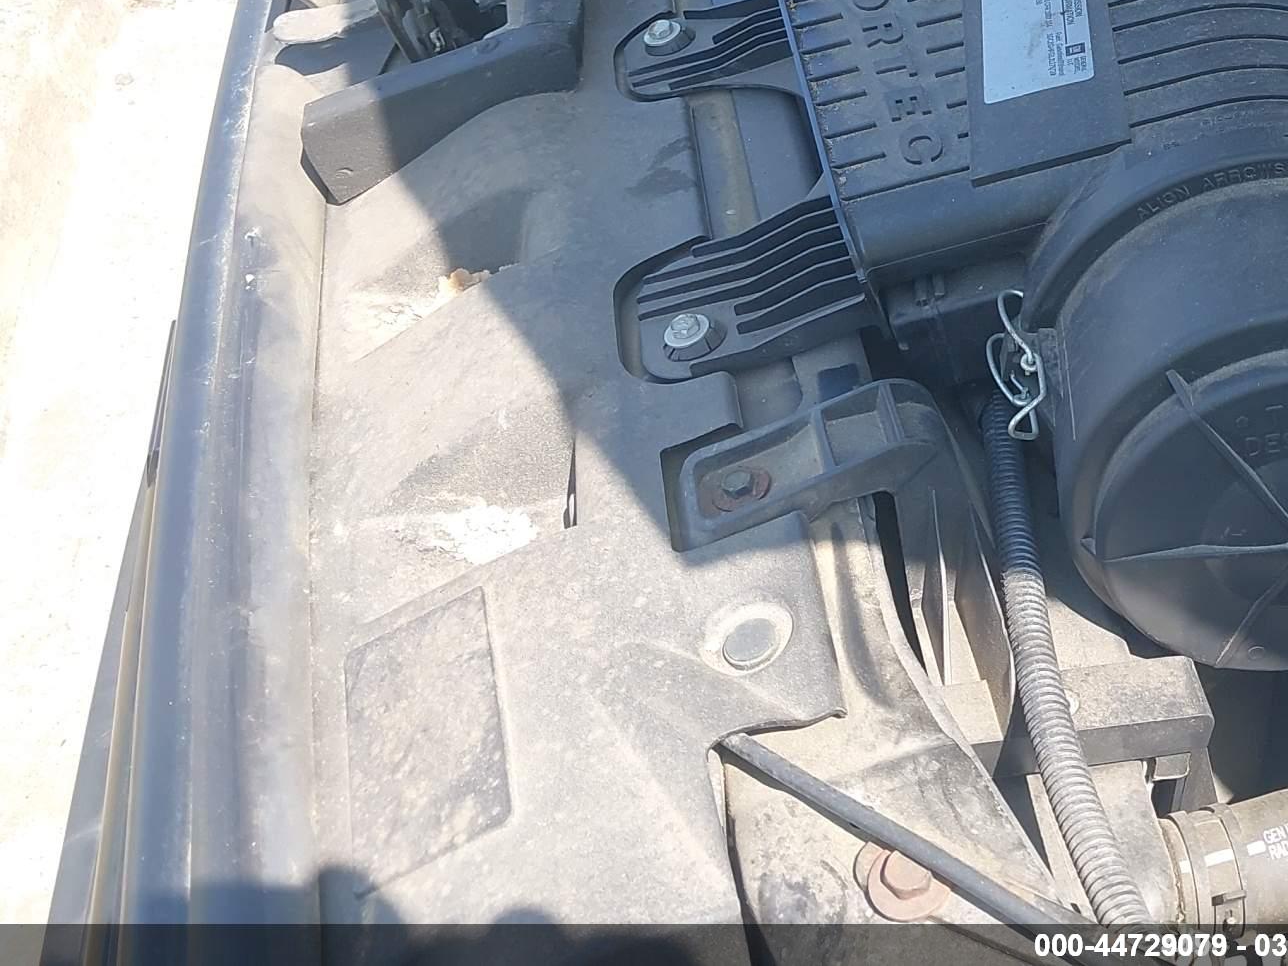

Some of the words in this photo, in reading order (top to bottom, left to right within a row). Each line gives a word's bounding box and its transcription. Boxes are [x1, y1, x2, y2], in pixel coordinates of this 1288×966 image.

[1136, 185, 1192, 221] ALIGN
[1202, 162, 1287, 191] ARROWS
[1263, 824, 1287, 844] GEN
